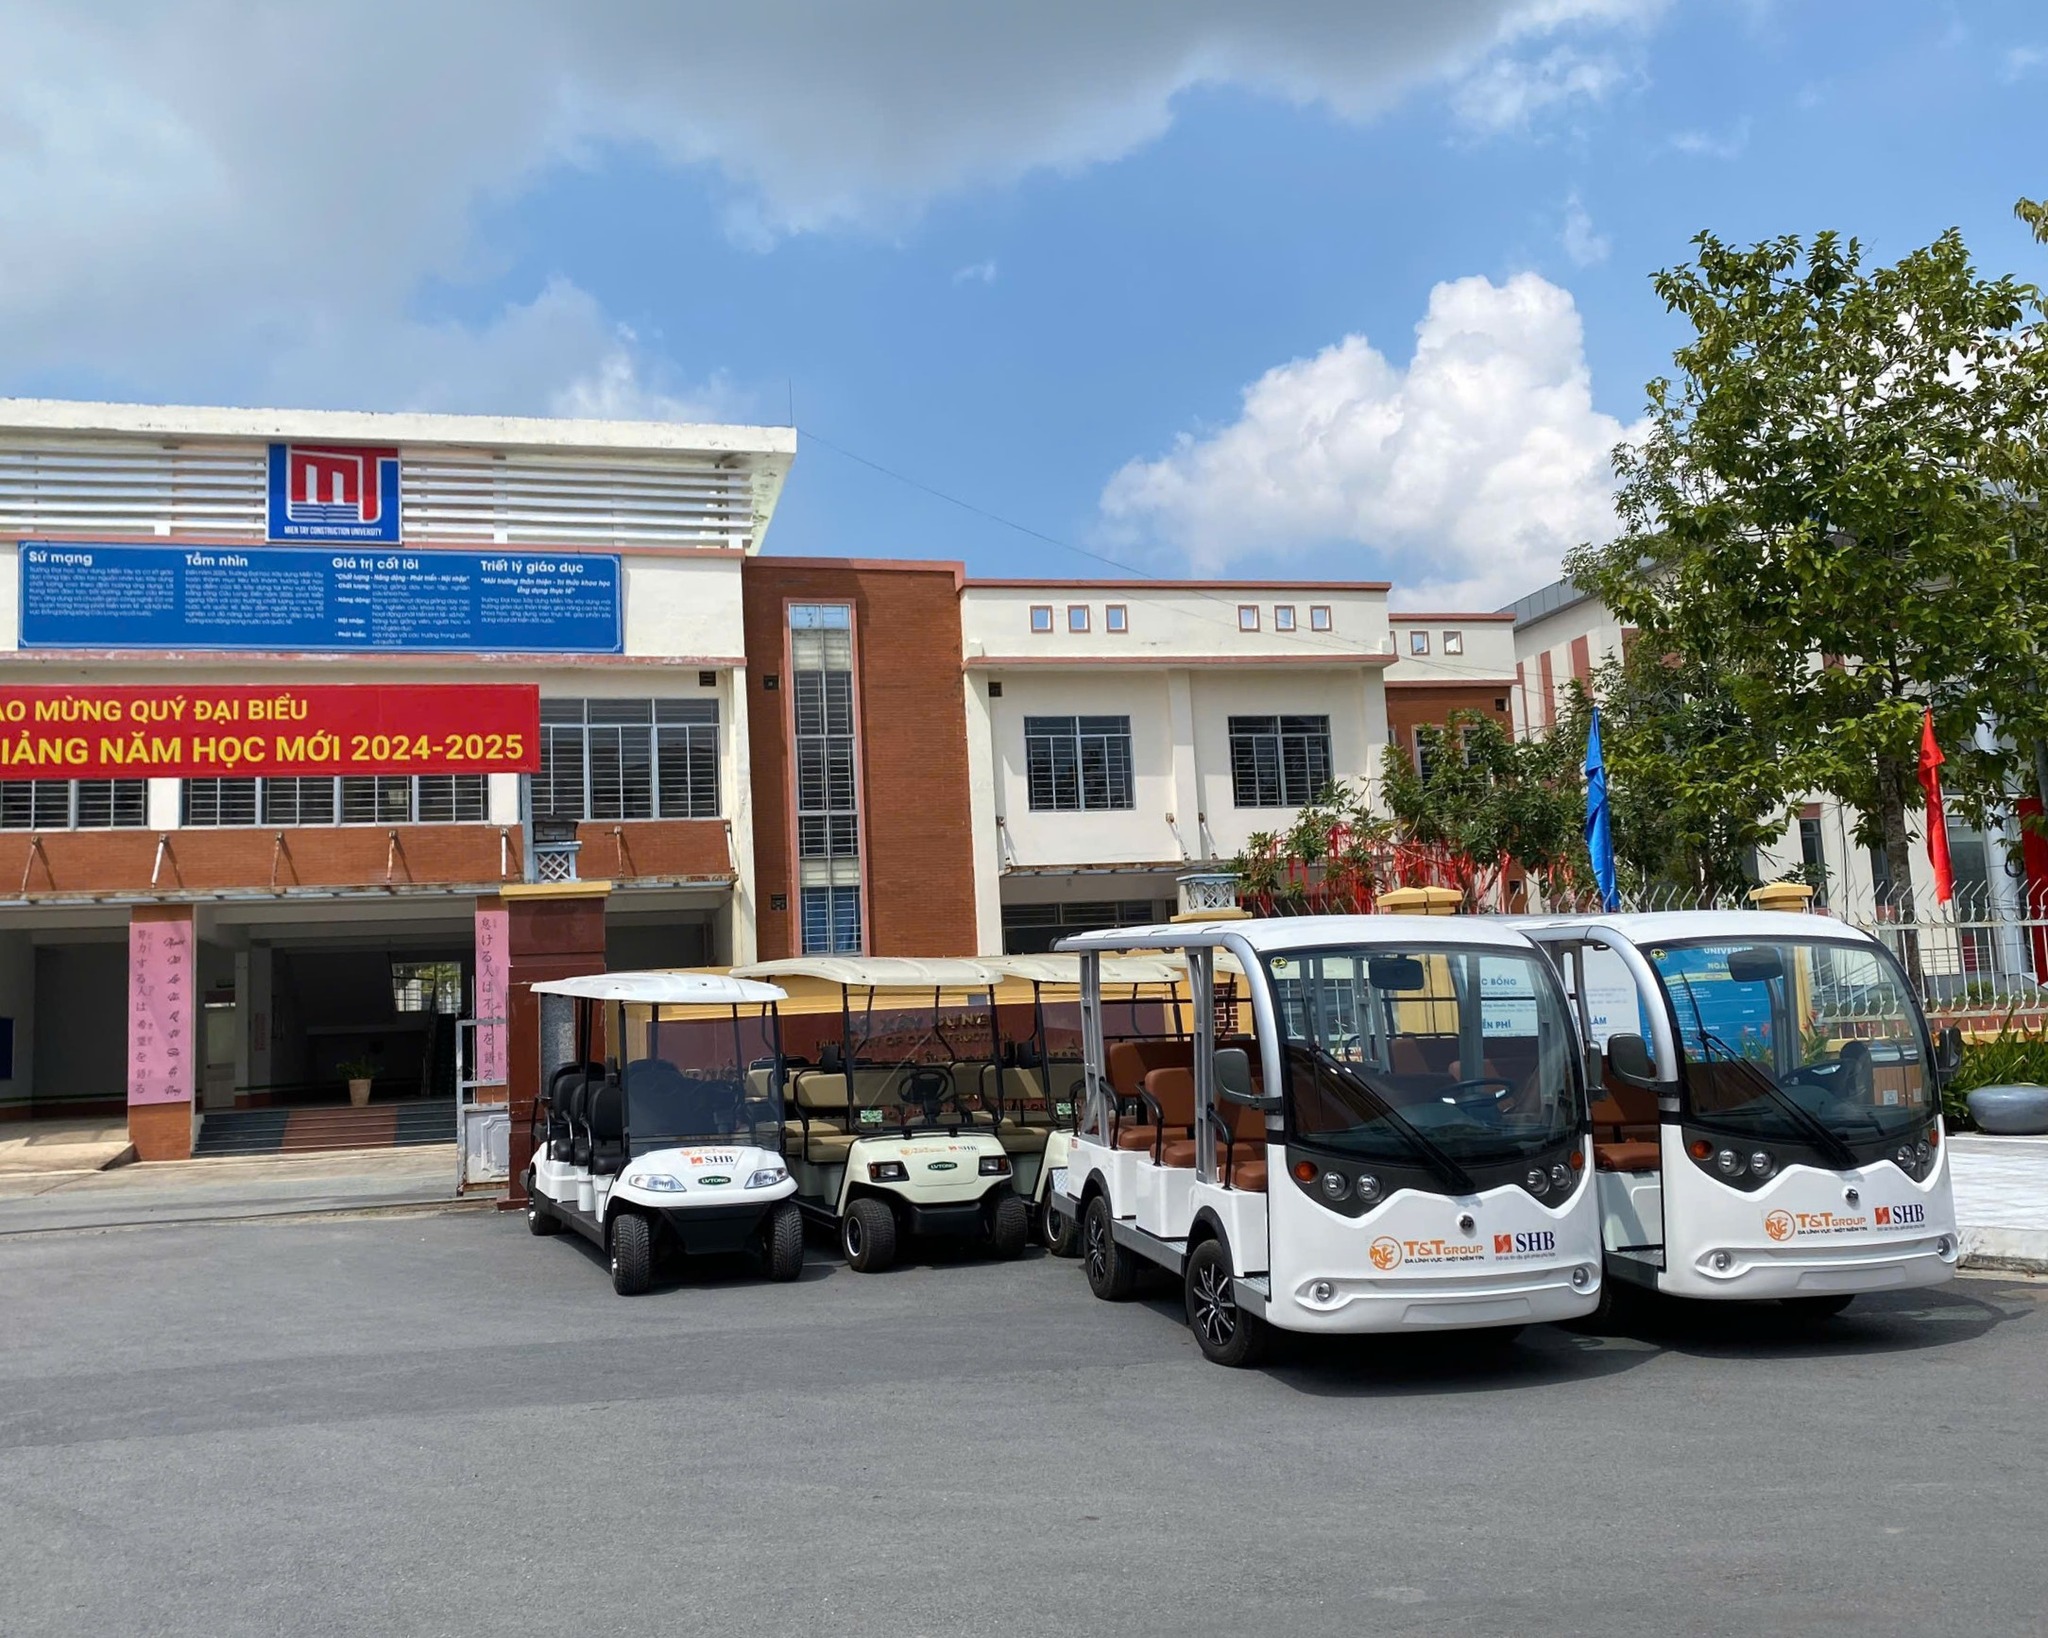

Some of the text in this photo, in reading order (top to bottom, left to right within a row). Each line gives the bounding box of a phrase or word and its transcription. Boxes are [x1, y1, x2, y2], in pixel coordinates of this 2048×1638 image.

[309, 526, 350, 536] CONSTRUCTION
[350, 527, 382, 537] UNIVERSITY
[29, 550, 93, 567] Sứ mạng
[185, 551, 248, 567] Tầm nhìn
[332, 556, 419, 572] Giá trị cốt lõi
[480, 558, 584, 576] Triết lý giáo dục
[35, 695, 122, 721] MỪNG
[130, 695, 187, 724] QUÝ
[194, 699, 239, 725] ĐẠI
[248, 692, 307, 720] BIỂU
[100, 731, 181, 764] NĂM
[193, 736, 266, 768] HỌC
[276, 729, 340, 762] MỚI
[351, 734, 523, 761] 2024-2025
[704, 1155, 734, 1164] SHB
[1796, 1212, 1867, 1228] T&T GROUP
[1892, 1203, 1925, 1225] SHB
[1403, 1239, 1484, 1257] T&T GROUP
[1515, 1230, 1556, 1253] SHB
